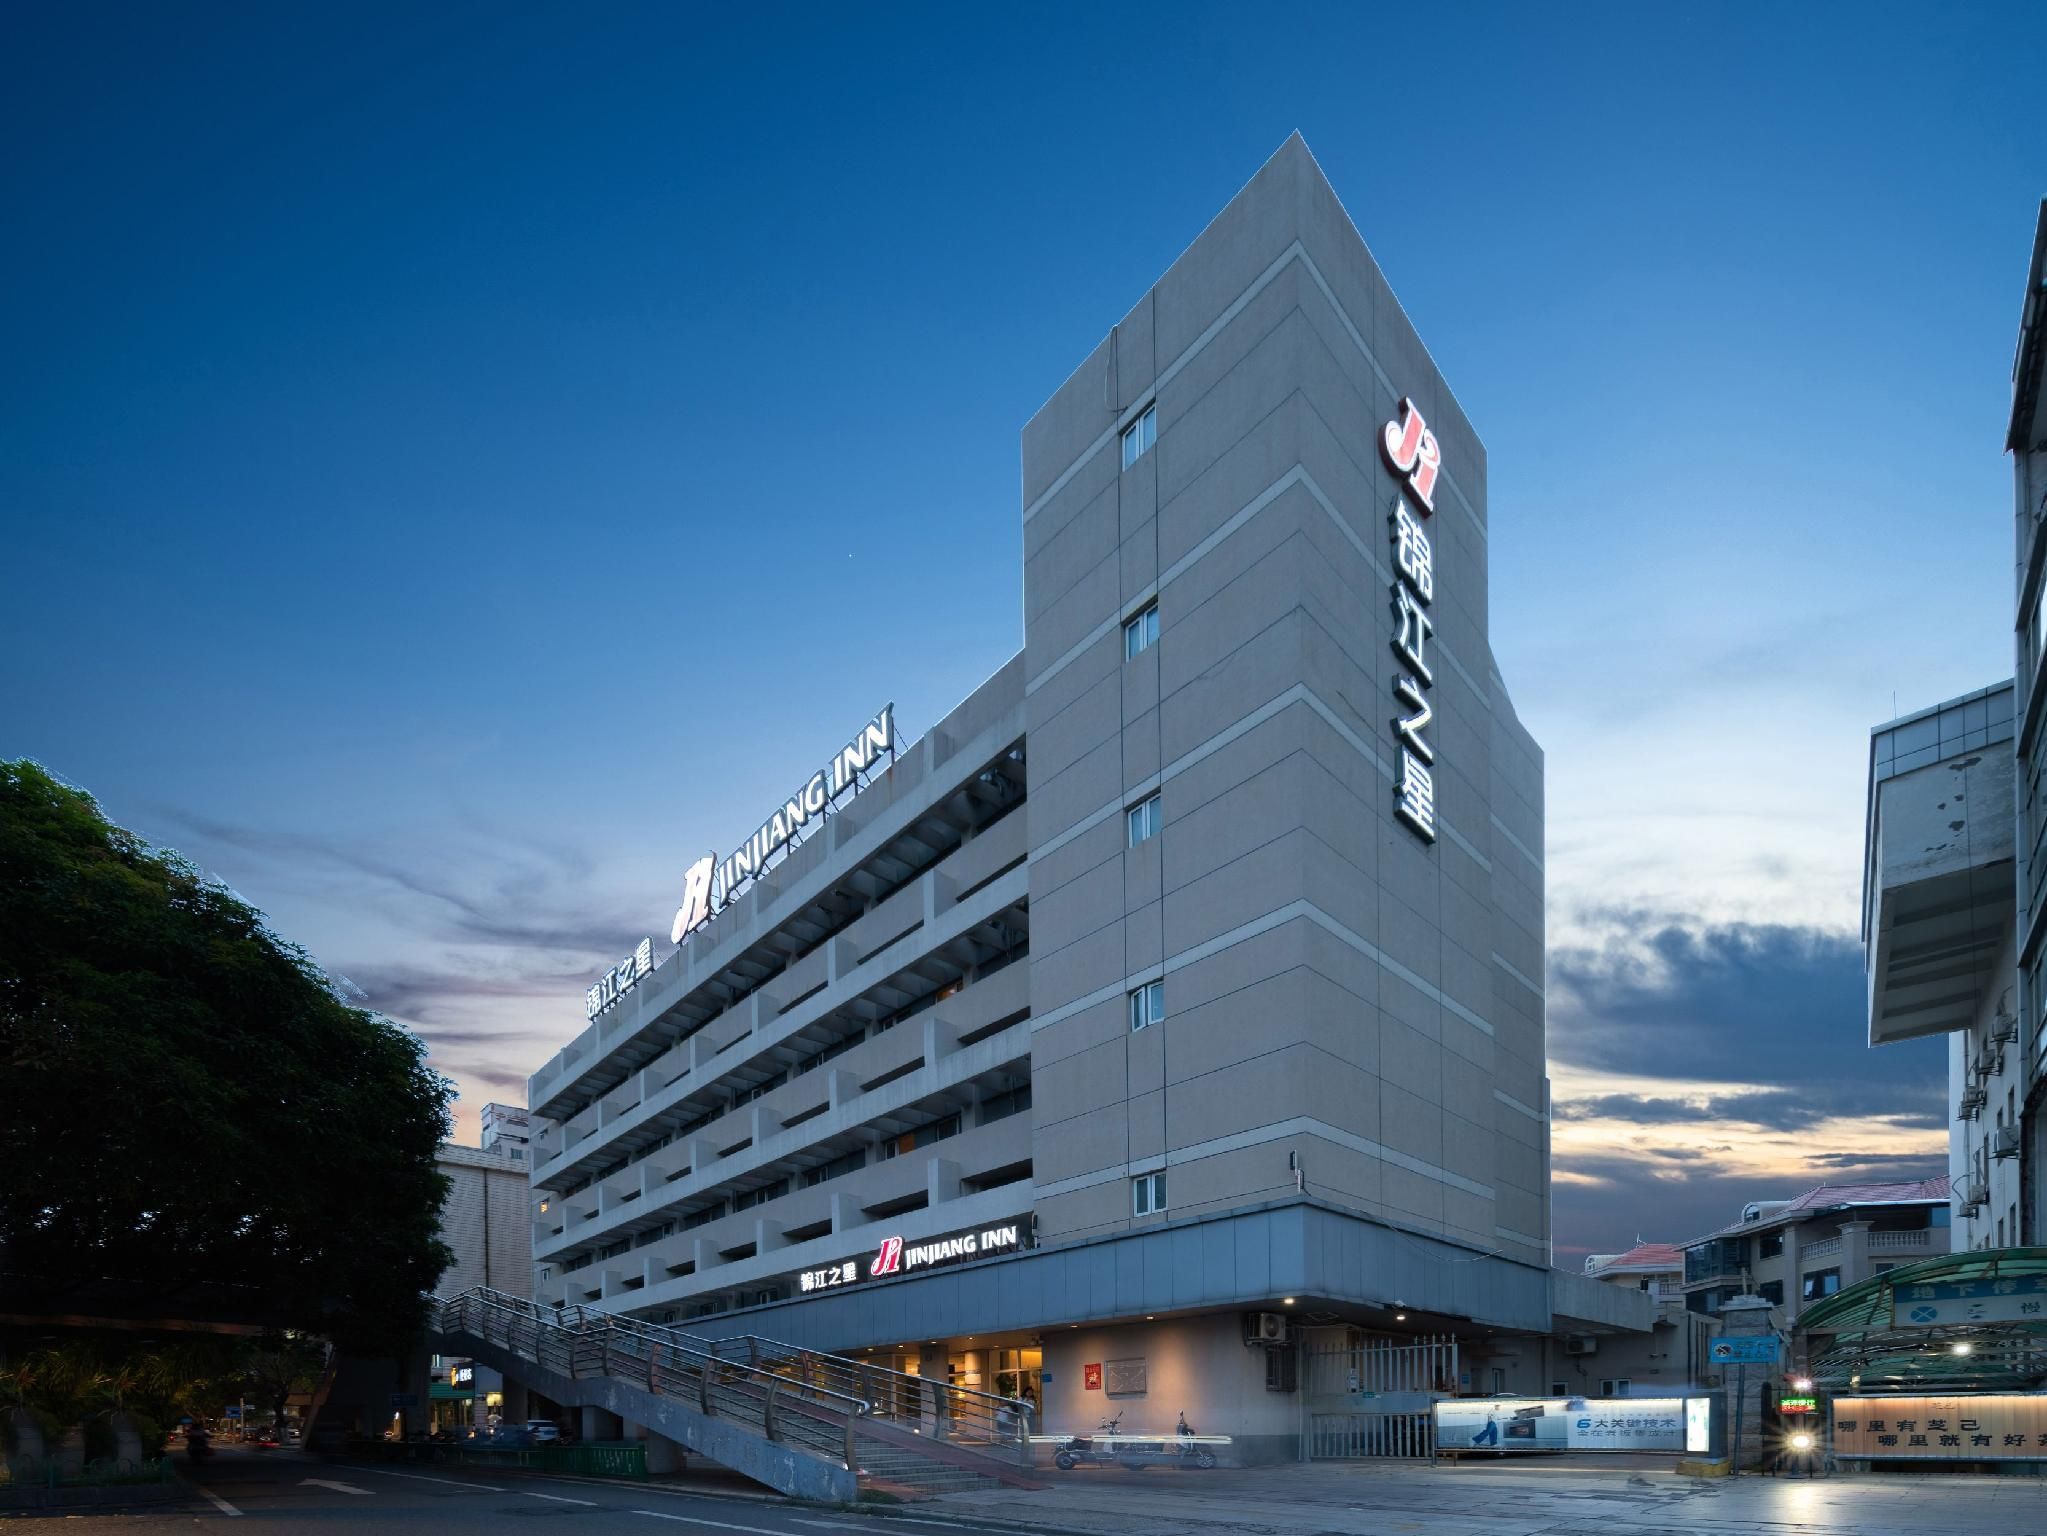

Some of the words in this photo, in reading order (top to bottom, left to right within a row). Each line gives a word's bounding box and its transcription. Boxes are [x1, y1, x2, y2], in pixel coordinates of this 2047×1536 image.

[1392, 499, 1435, 838] 锦江之星
[586, 937, 653, 1020] 锦江之星
[718, 770, 828, 907] JINJIANG
[830, 704, 893, 793] INN
[800, 1262, 857, 1292] 锦江之星
[905, 1235, 976, 1269] JINJIANG
[981, 1226, 1017, 1249] INN
[1576, 1418, 1677, 1429] 6大关键技术
[1837, 1419, 1981, 1433] 哪里有芝己
